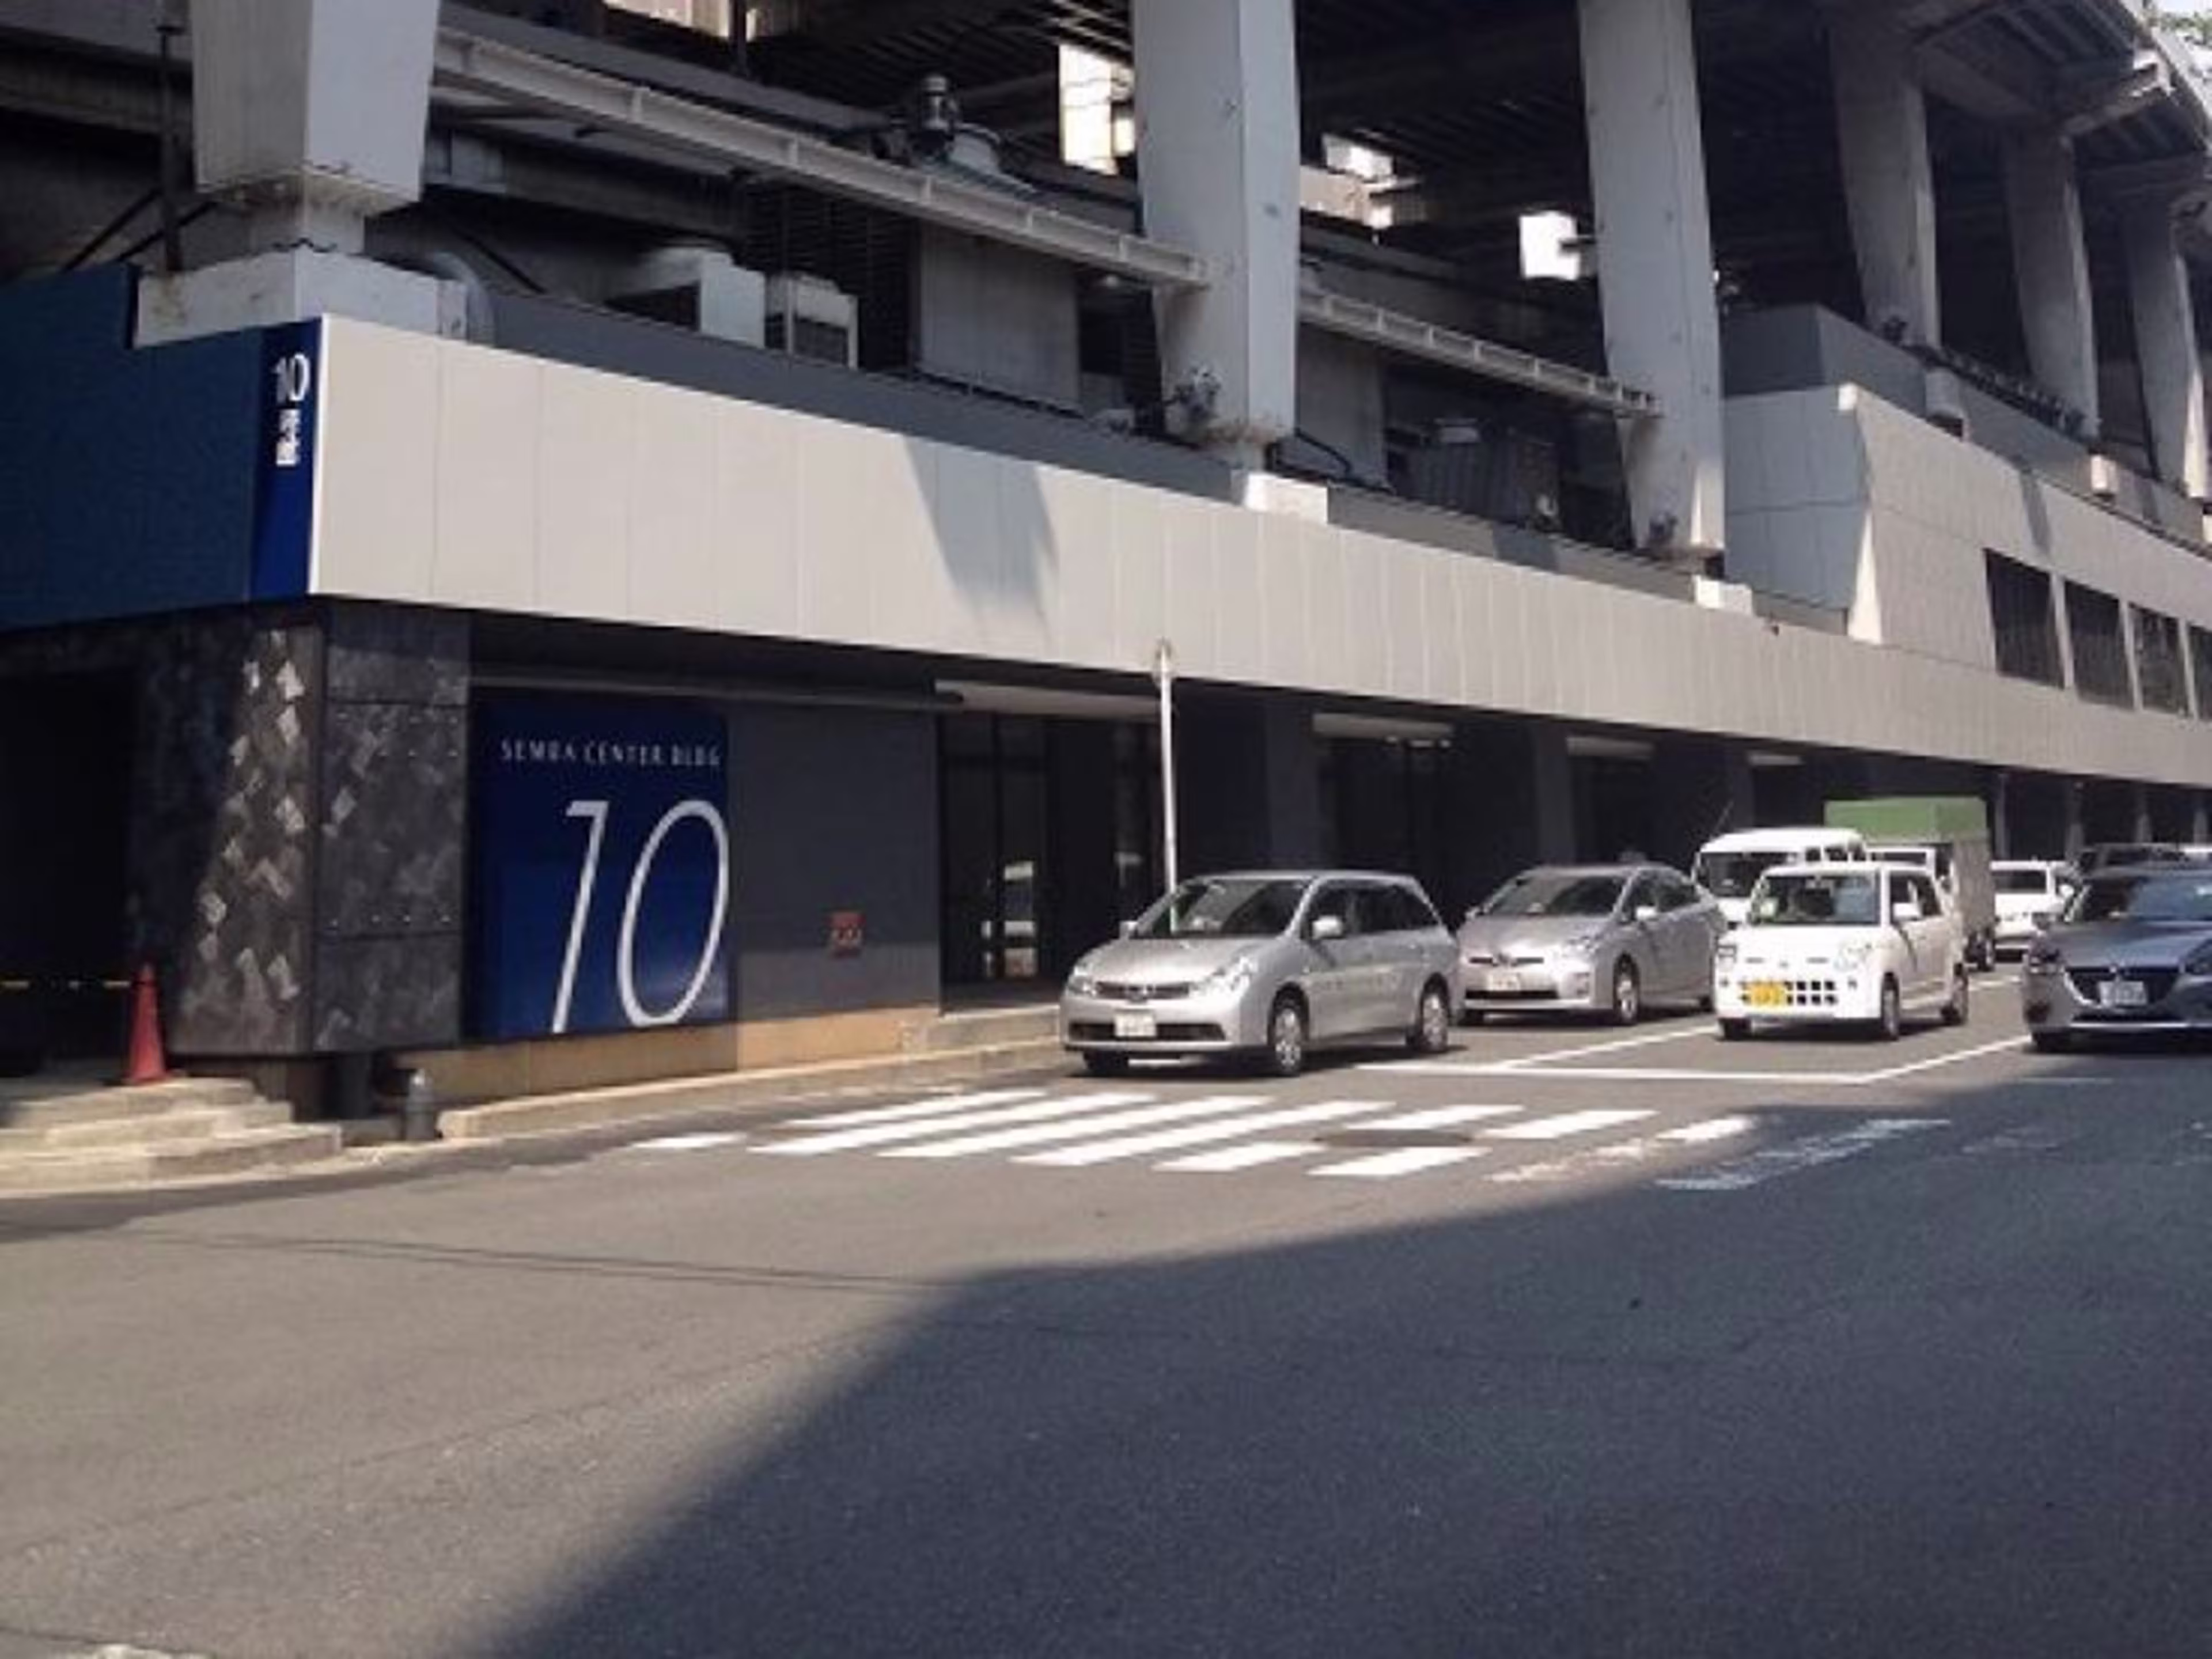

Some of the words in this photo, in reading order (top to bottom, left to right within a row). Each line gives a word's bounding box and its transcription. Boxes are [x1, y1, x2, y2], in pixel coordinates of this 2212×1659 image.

[272, 353, 310, 403] 10
[501, 739, 576, 762] SEMBA
[584, 740, 664, 765] CENTER
[551, 800, 730, 1035] 10
